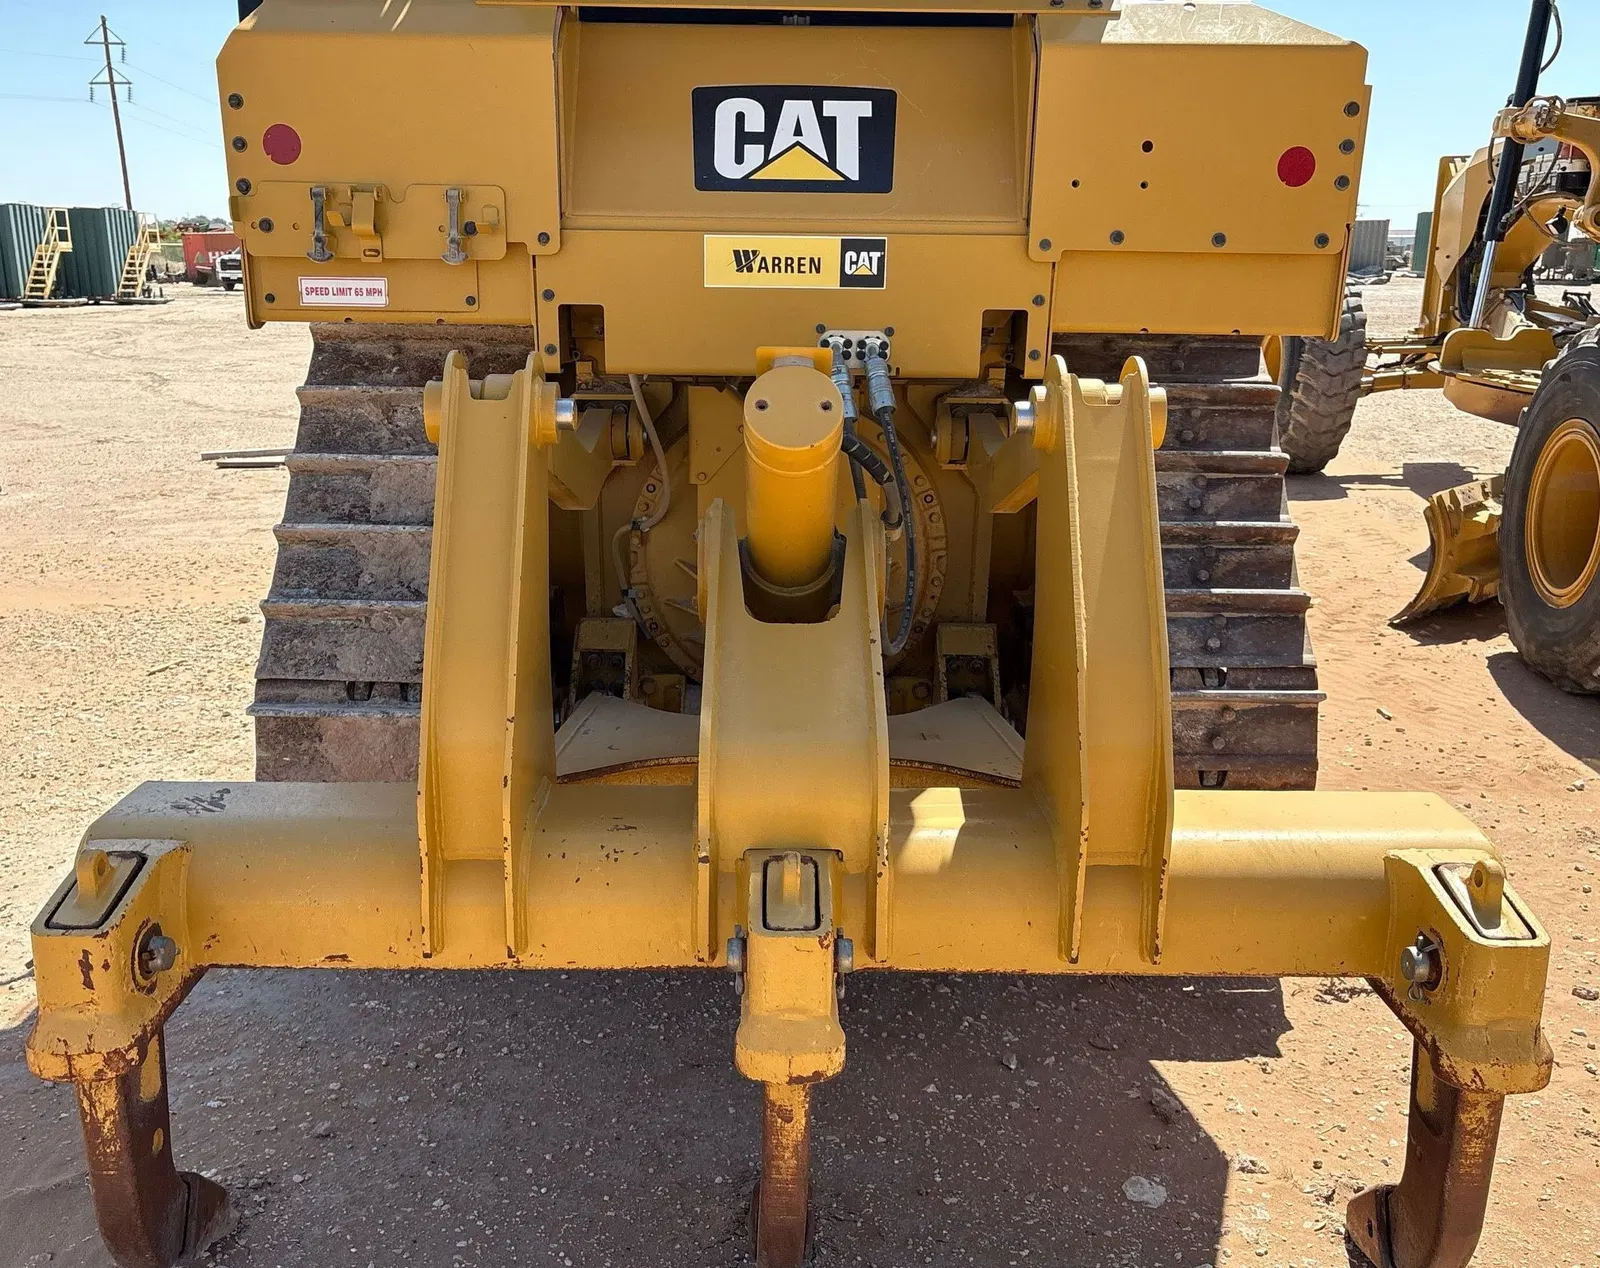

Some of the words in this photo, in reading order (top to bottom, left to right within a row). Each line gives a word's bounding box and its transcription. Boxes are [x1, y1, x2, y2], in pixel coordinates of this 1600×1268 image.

[713, 97, 873, 181] CAT
[731, 249, 821, 274] WARREN
[844, 250, 881, 276] CAT
[304, 286, 330, 296] SPEED
[331, 287, 353, 297] LIMIT
[354, 287, 364, 297] 65
[365, 287, 383, 297] MPH
